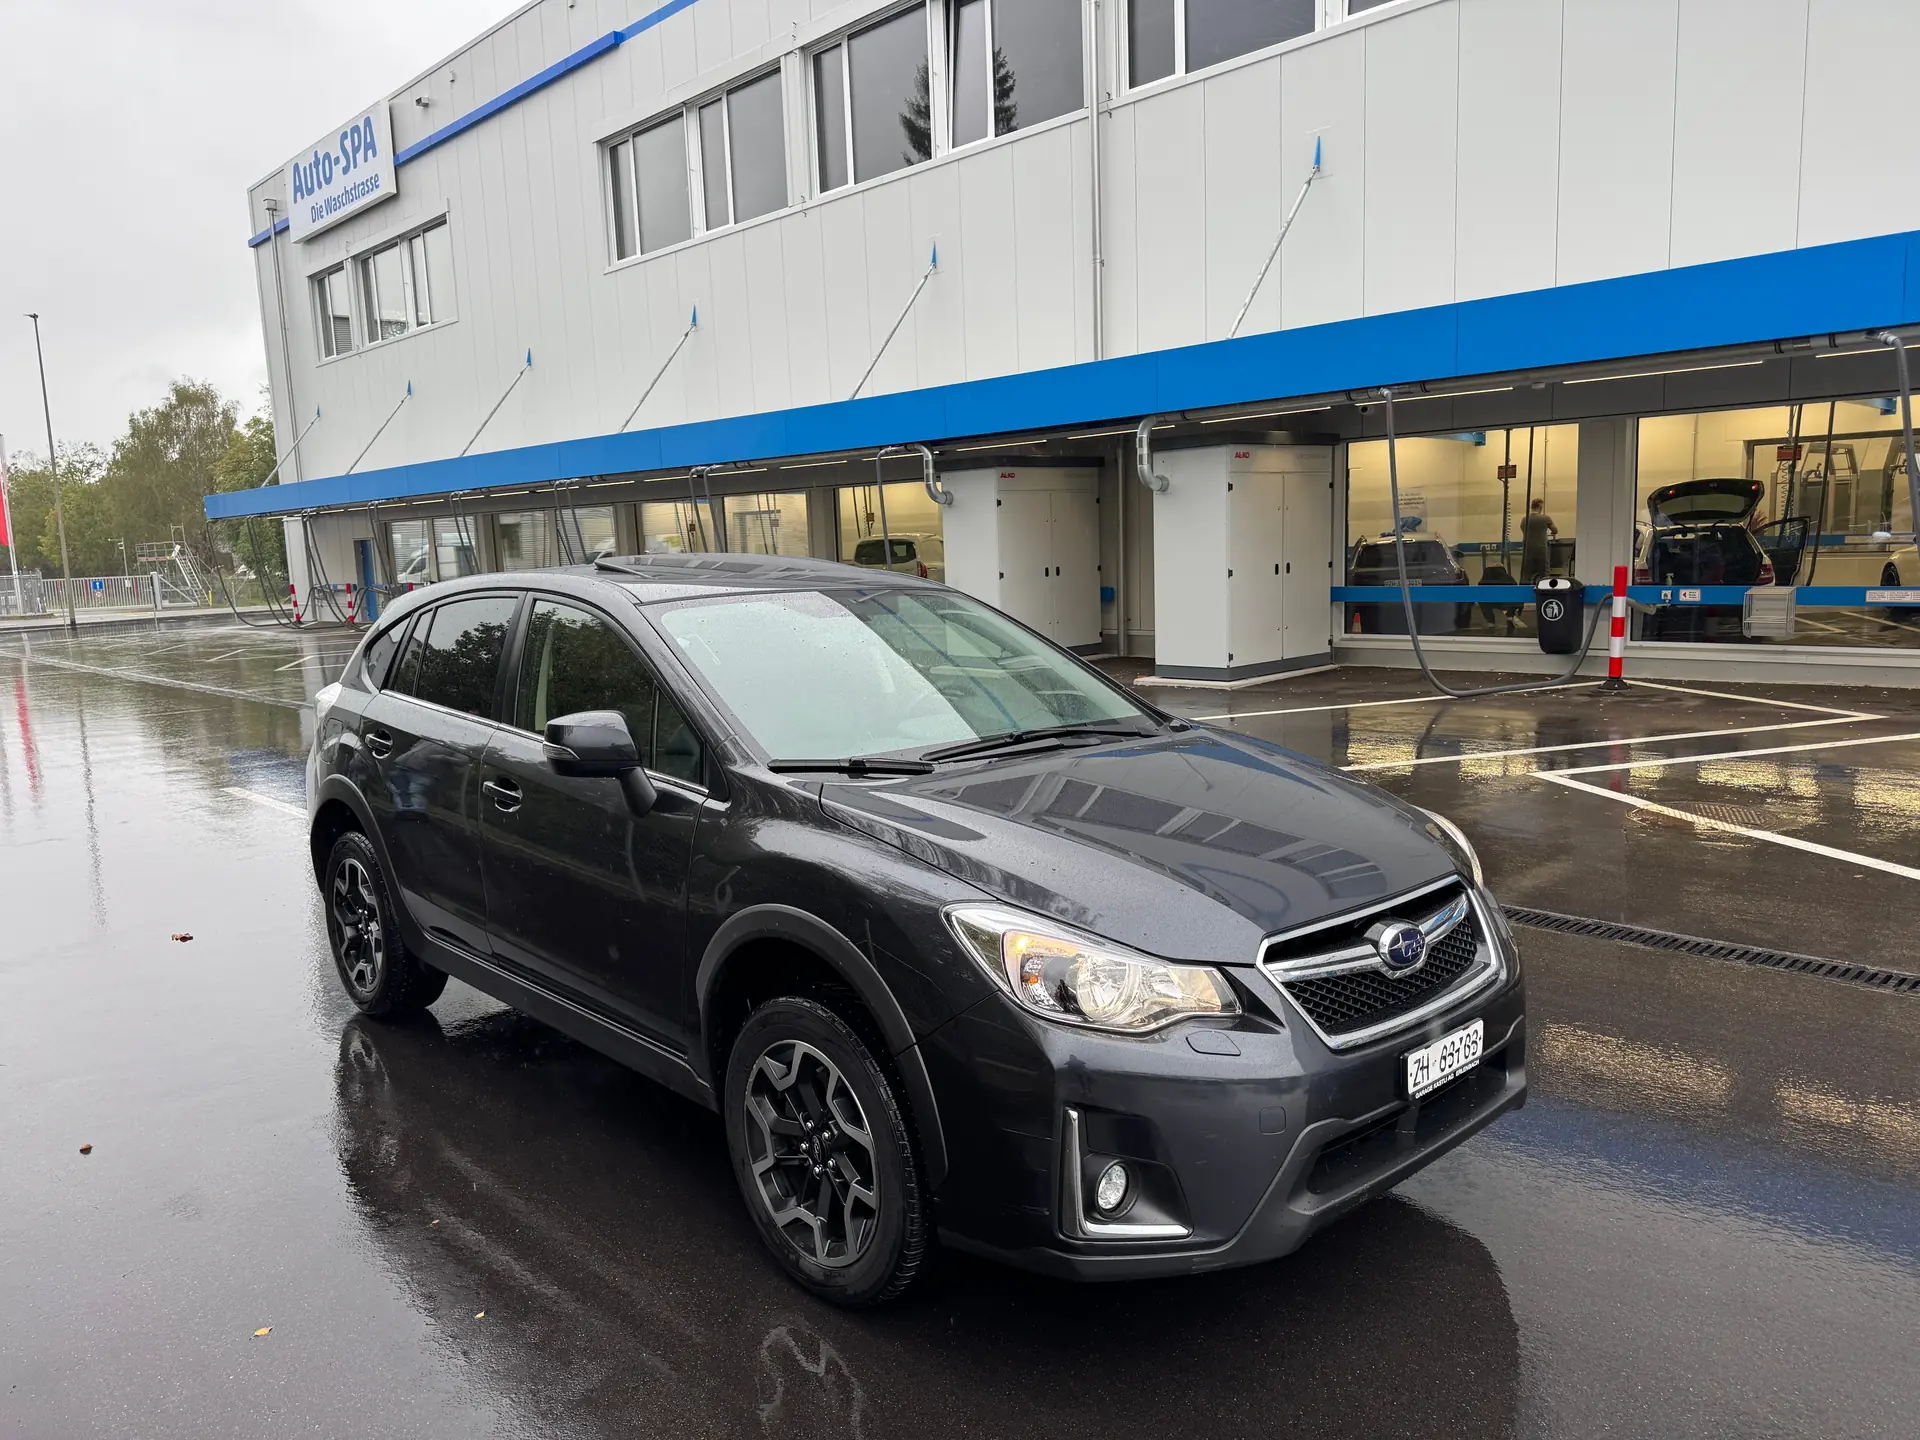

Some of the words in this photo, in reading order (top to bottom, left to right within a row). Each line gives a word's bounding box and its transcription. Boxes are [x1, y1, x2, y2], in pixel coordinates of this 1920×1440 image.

[292, 116, 377, 204] Auto-SPA
[310, 203, 324, 223] Die
[324, 173, 380, 216] Waschstrasse
[1413, 1053, 1429, 1088] ZH
[1415, 1085, 1433, 1099] GARAGE
